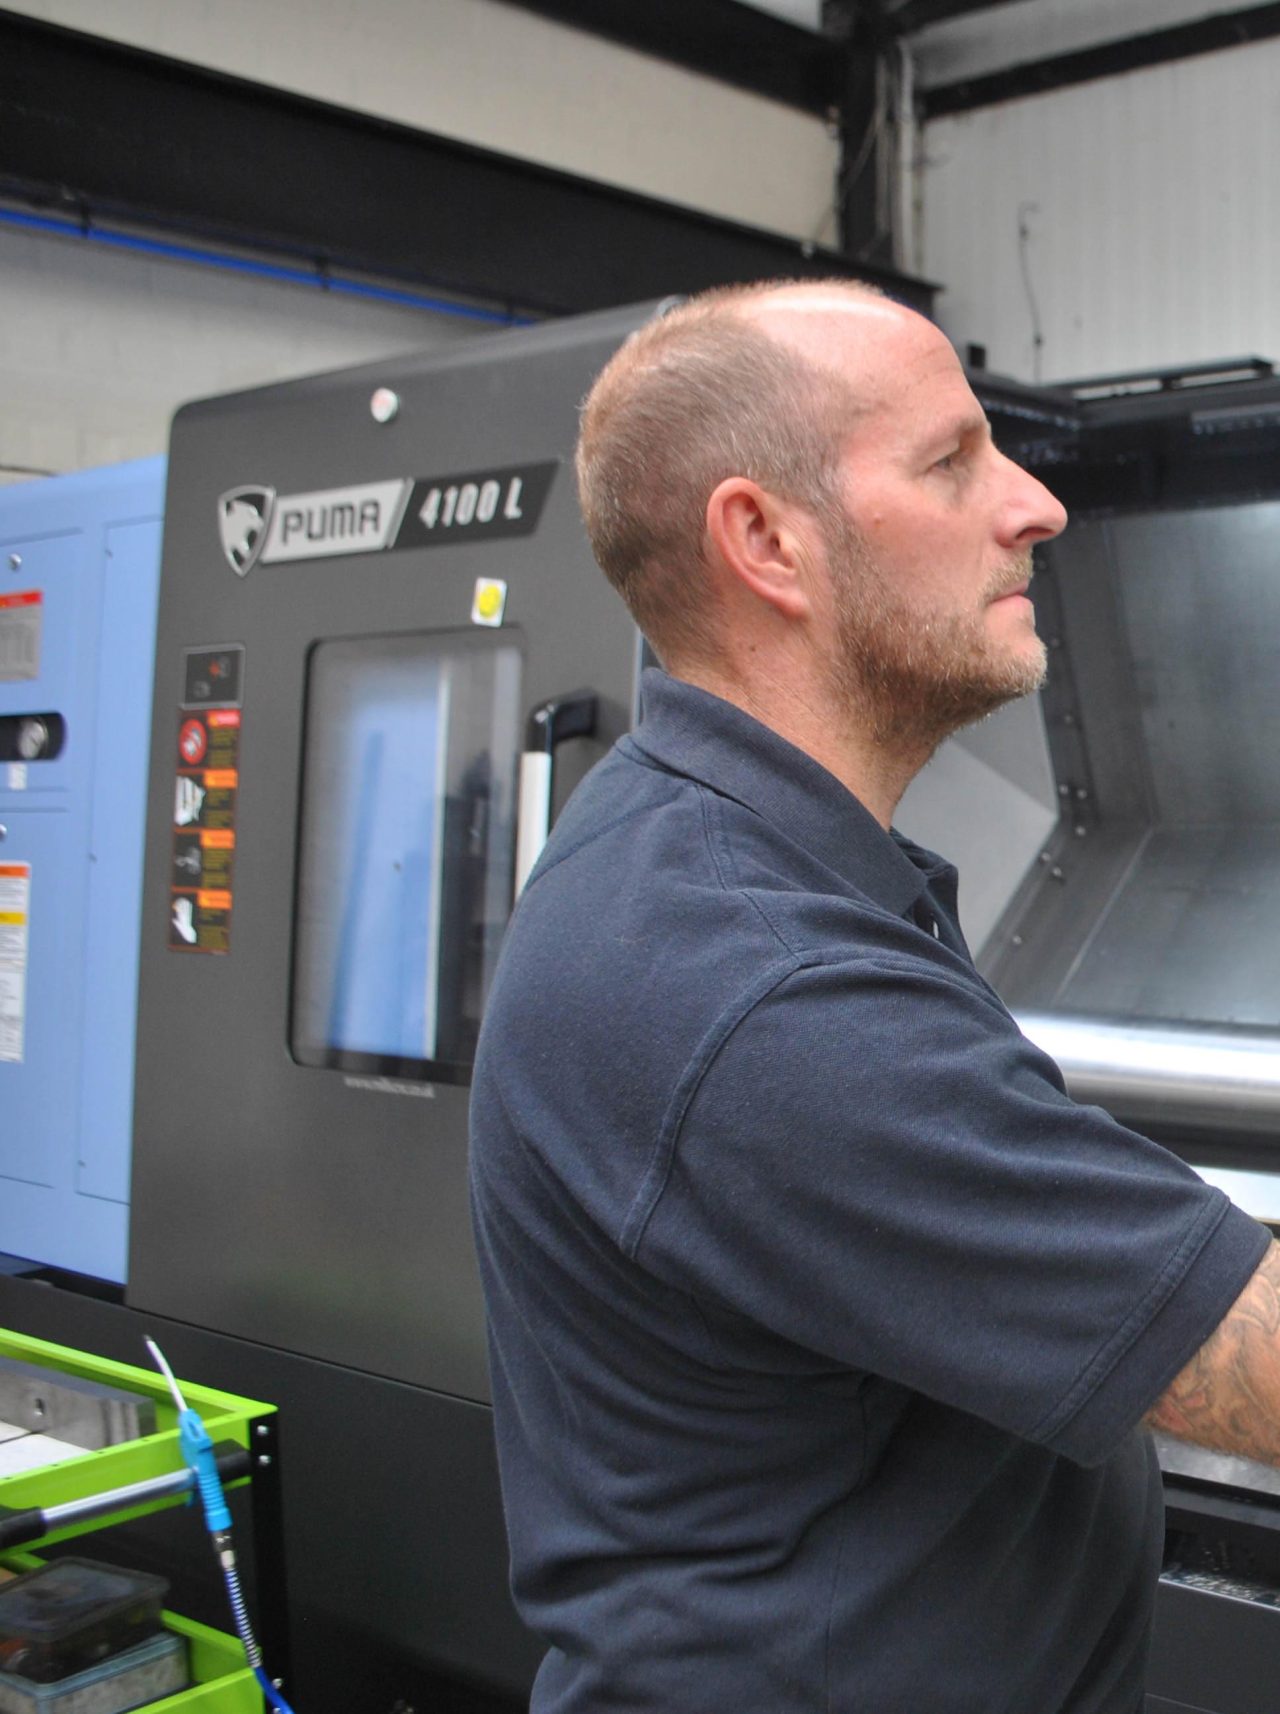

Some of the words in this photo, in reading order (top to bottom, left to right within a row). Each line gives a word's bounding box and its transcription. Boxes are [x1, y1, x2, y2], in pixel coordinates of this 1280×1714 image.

[281, 501, 380, 546] PUMA
[419, 479, 500, 529] 4100
[504, 477, 522, 519] L
